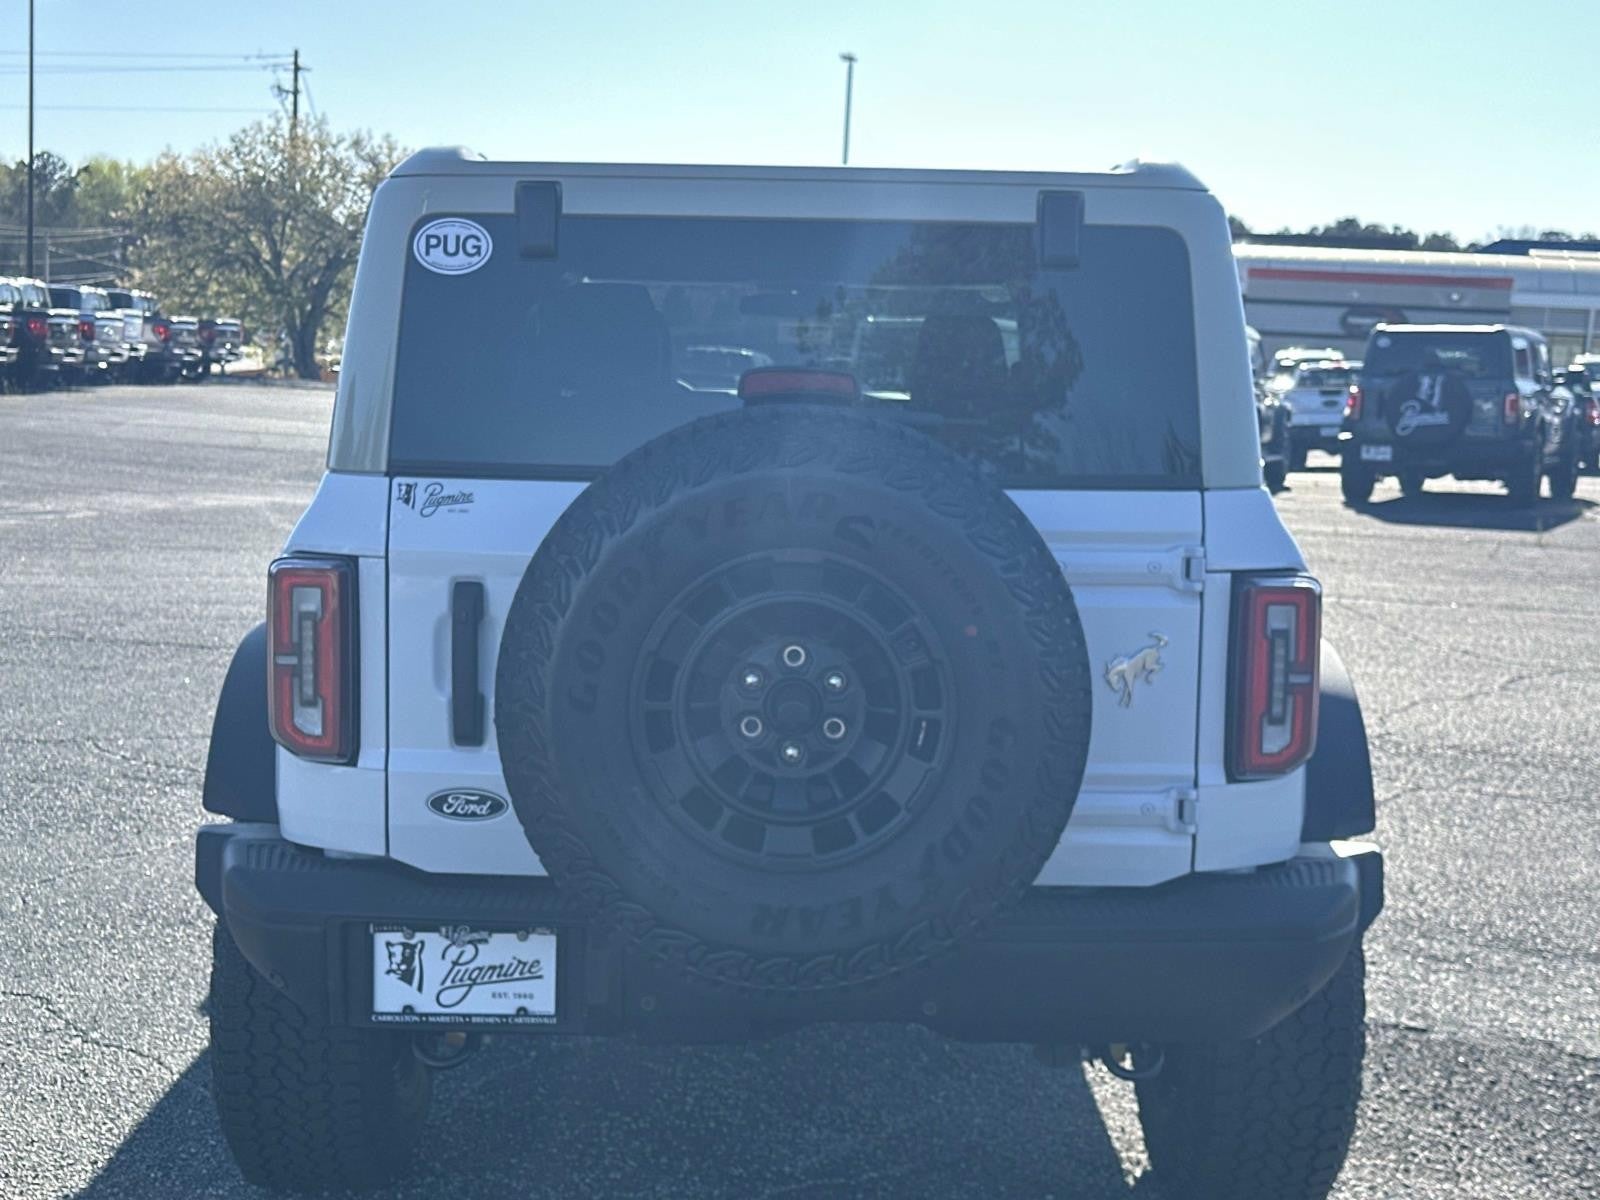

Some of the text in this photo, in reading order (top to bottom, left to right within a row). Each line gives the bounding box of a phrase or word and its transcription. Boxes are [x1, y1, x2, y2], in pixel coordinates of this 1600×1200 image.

[425, 234, 482, 257] PUG
[420, 482, 474, 517] Pugmire
[442, 794, 491, 815] Ford
[436, 943, 544, 1009] Pugmire
[428, 1015, 465, 1024] MARIETTA
